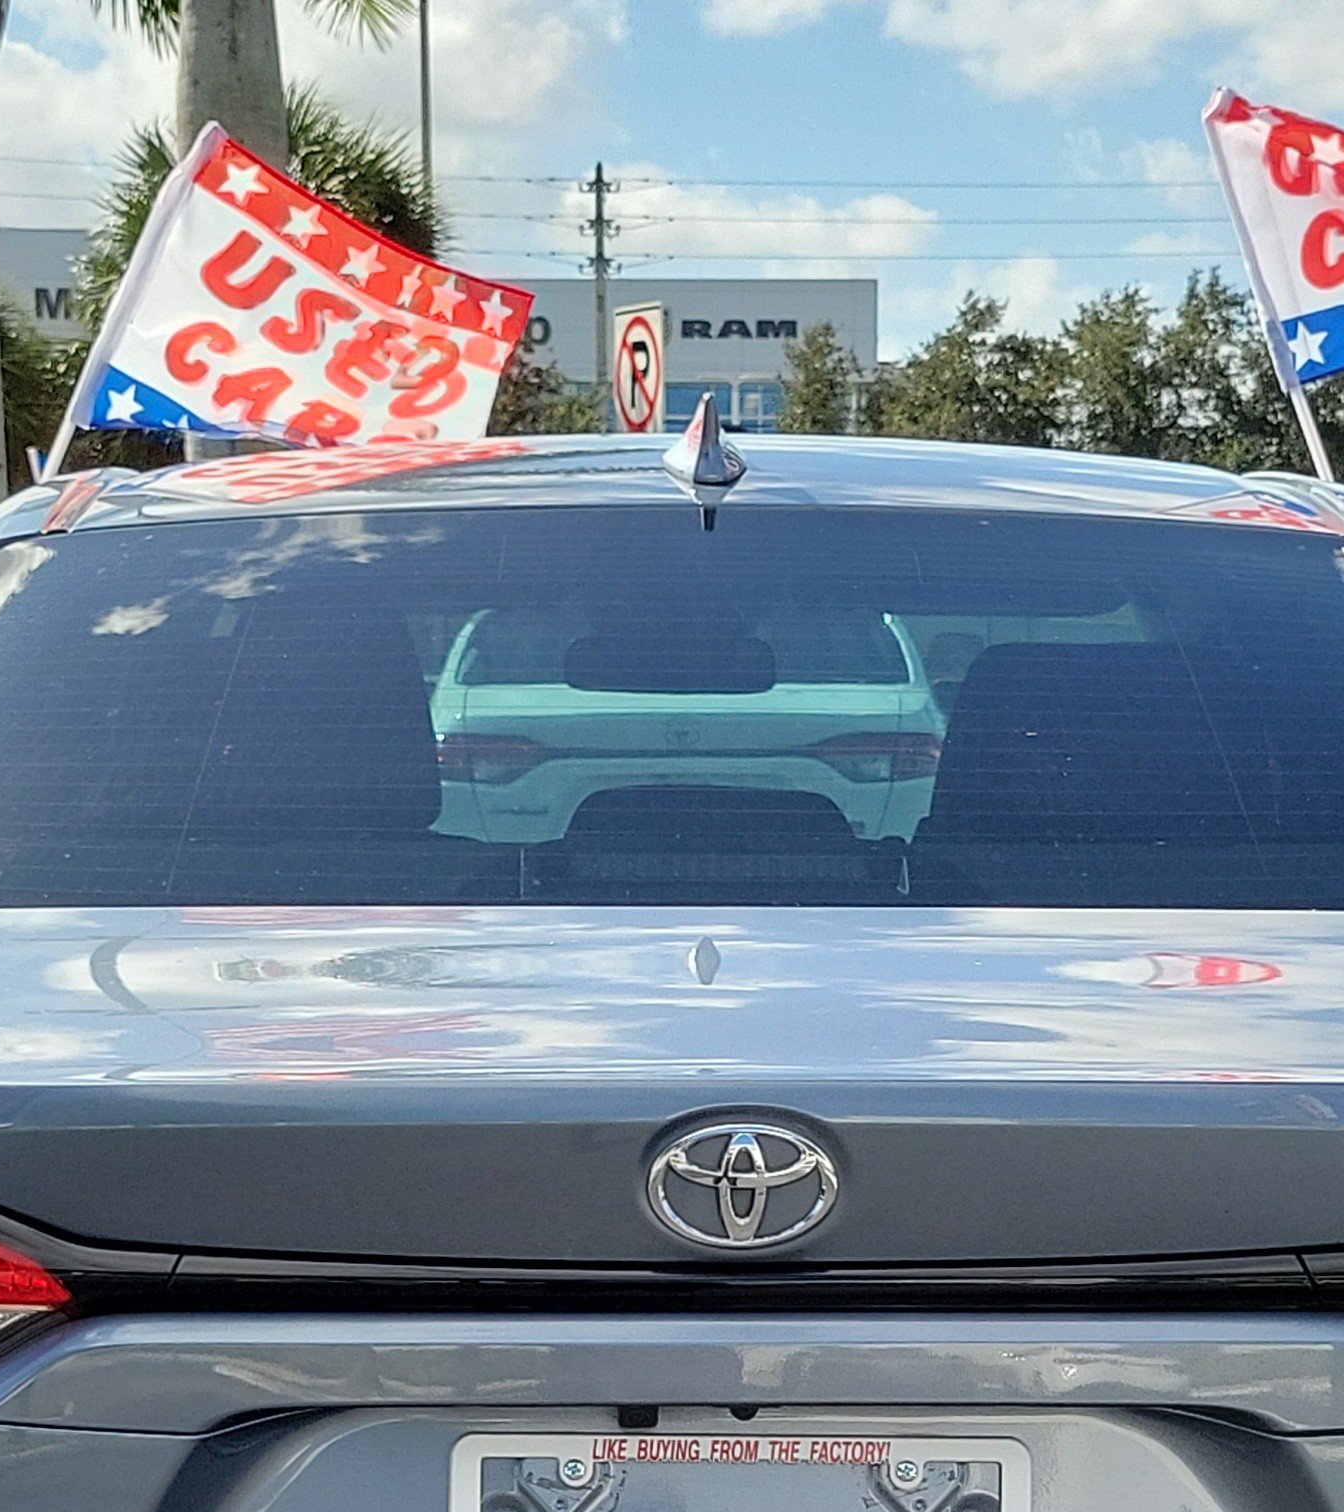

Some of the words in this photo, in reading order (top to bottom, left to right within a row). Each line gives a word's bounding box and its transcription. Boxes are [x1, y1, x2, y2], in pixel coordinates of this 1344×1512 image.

[200, 230, 468, 419] USED
[681, 319, 798, 339] RAM
[592, 1438, 628, 1461] LIKE
[637, 1438, 701, 1462] BUYING
[710, 1439, 760, 1462] FROM
[769, 1440, 801, 1462] THE
[809, 1440, 892, 1463] FACTORY!
